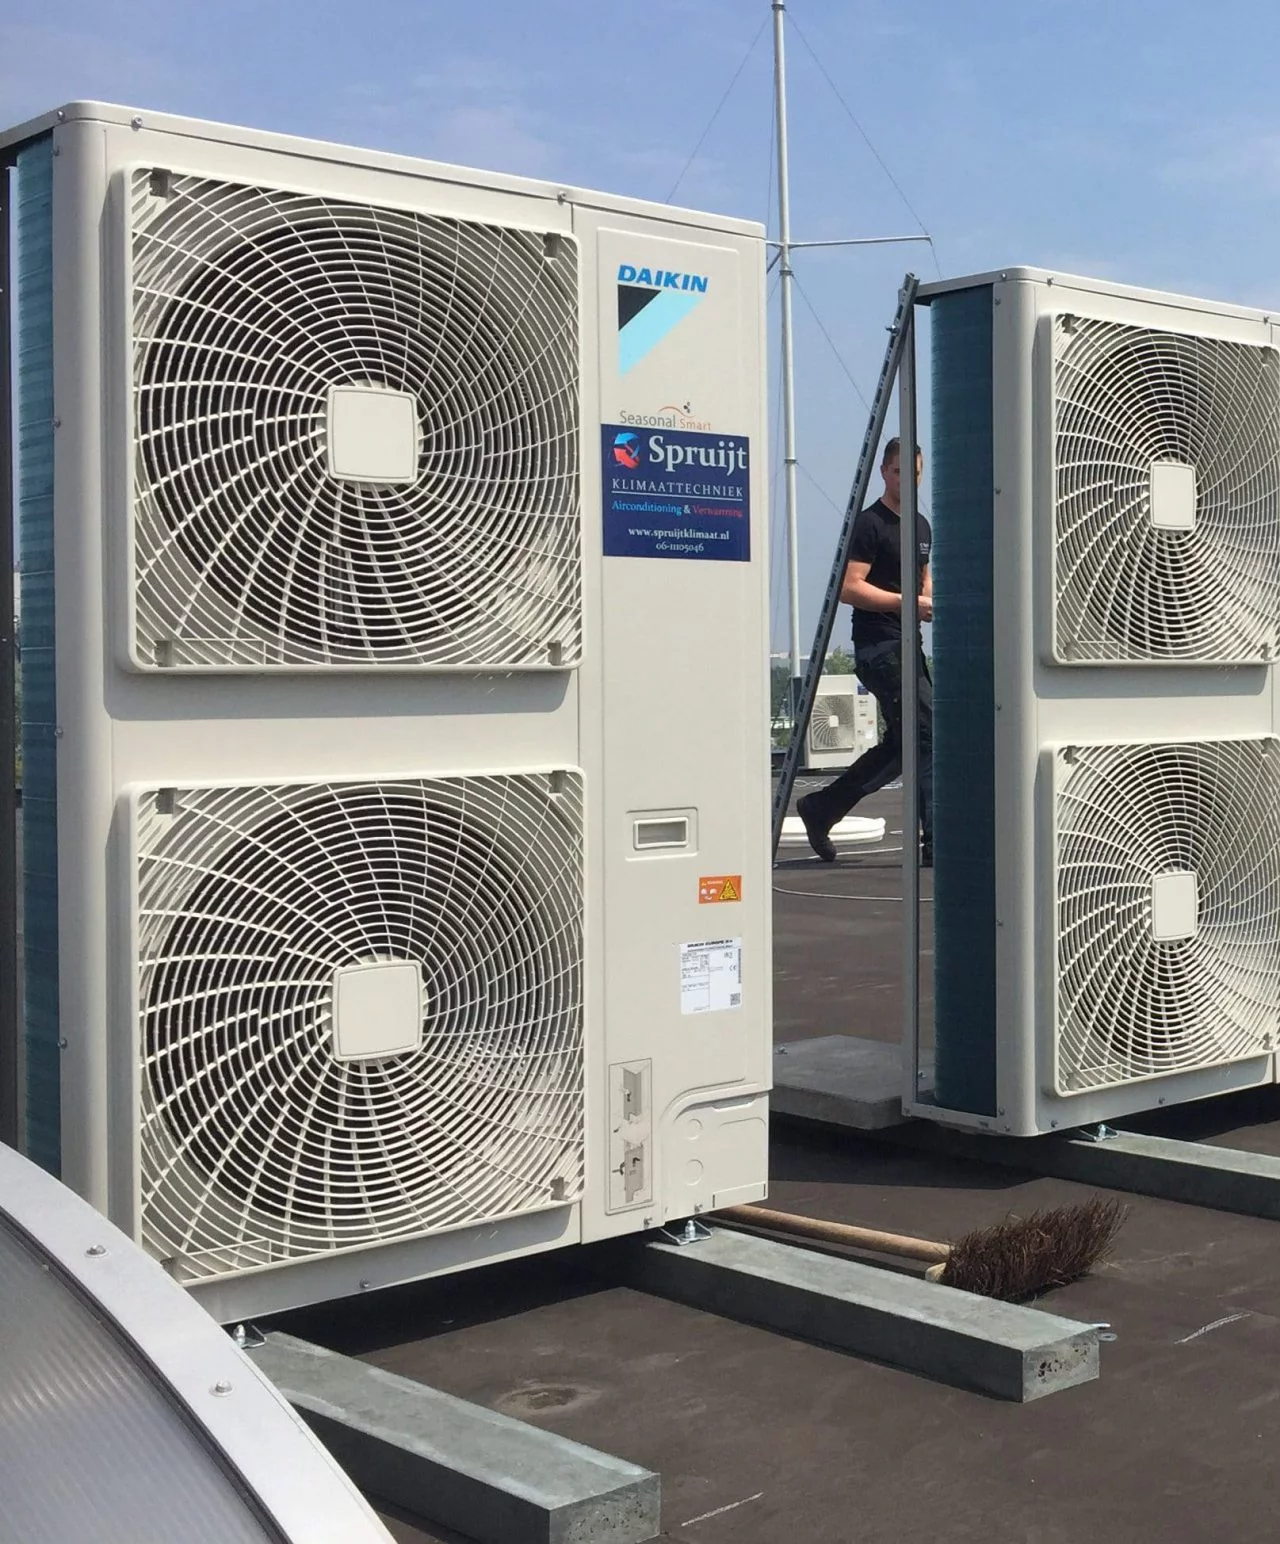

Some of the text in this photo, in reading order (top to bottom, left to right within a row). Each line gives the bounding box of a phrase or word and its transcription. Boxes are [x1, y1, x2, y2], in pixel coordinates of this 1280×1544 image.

[617, 264, 709, 293] DAIKIN
[620, 410, 712, 431] Seasonal Smart
[649, 435, 747, 476] Spruijt
[612, 478, 743, 497] KLIMAATTECHNIEK
[612, 500, 682, 516] Airconditioning
[683, 504, 691, 514] &
